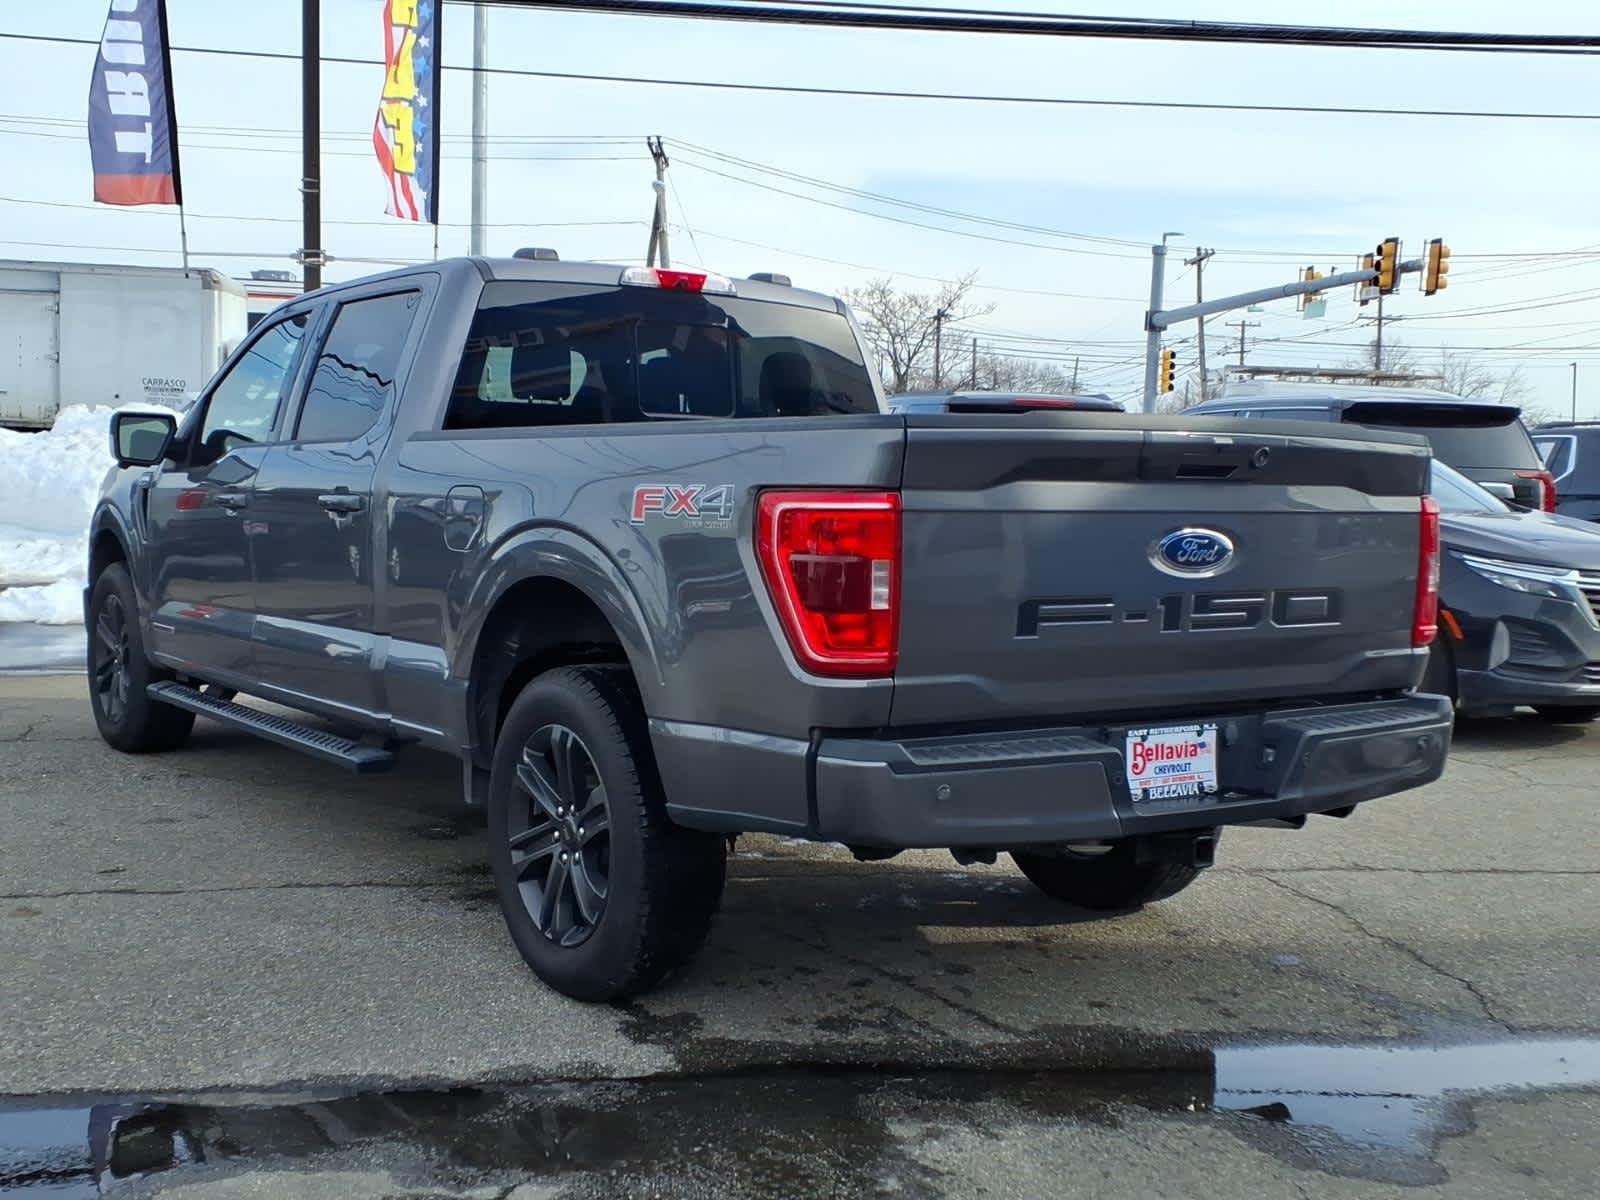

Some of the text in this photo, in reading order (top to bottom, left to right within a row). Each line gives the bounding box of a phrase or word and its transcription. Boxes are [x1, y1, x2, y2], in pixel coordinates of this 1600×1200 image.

[142, 377, 186, 388] CARRASCO
[630, 484, 735, 526] FX4
[1177, 538, 1218, 562] Ford
[1013, 590, 1343, 640] F-150
[1131, 741, 1198, 776] Bellavia
[1154, 762, 1192, 775] CHEVROLET
